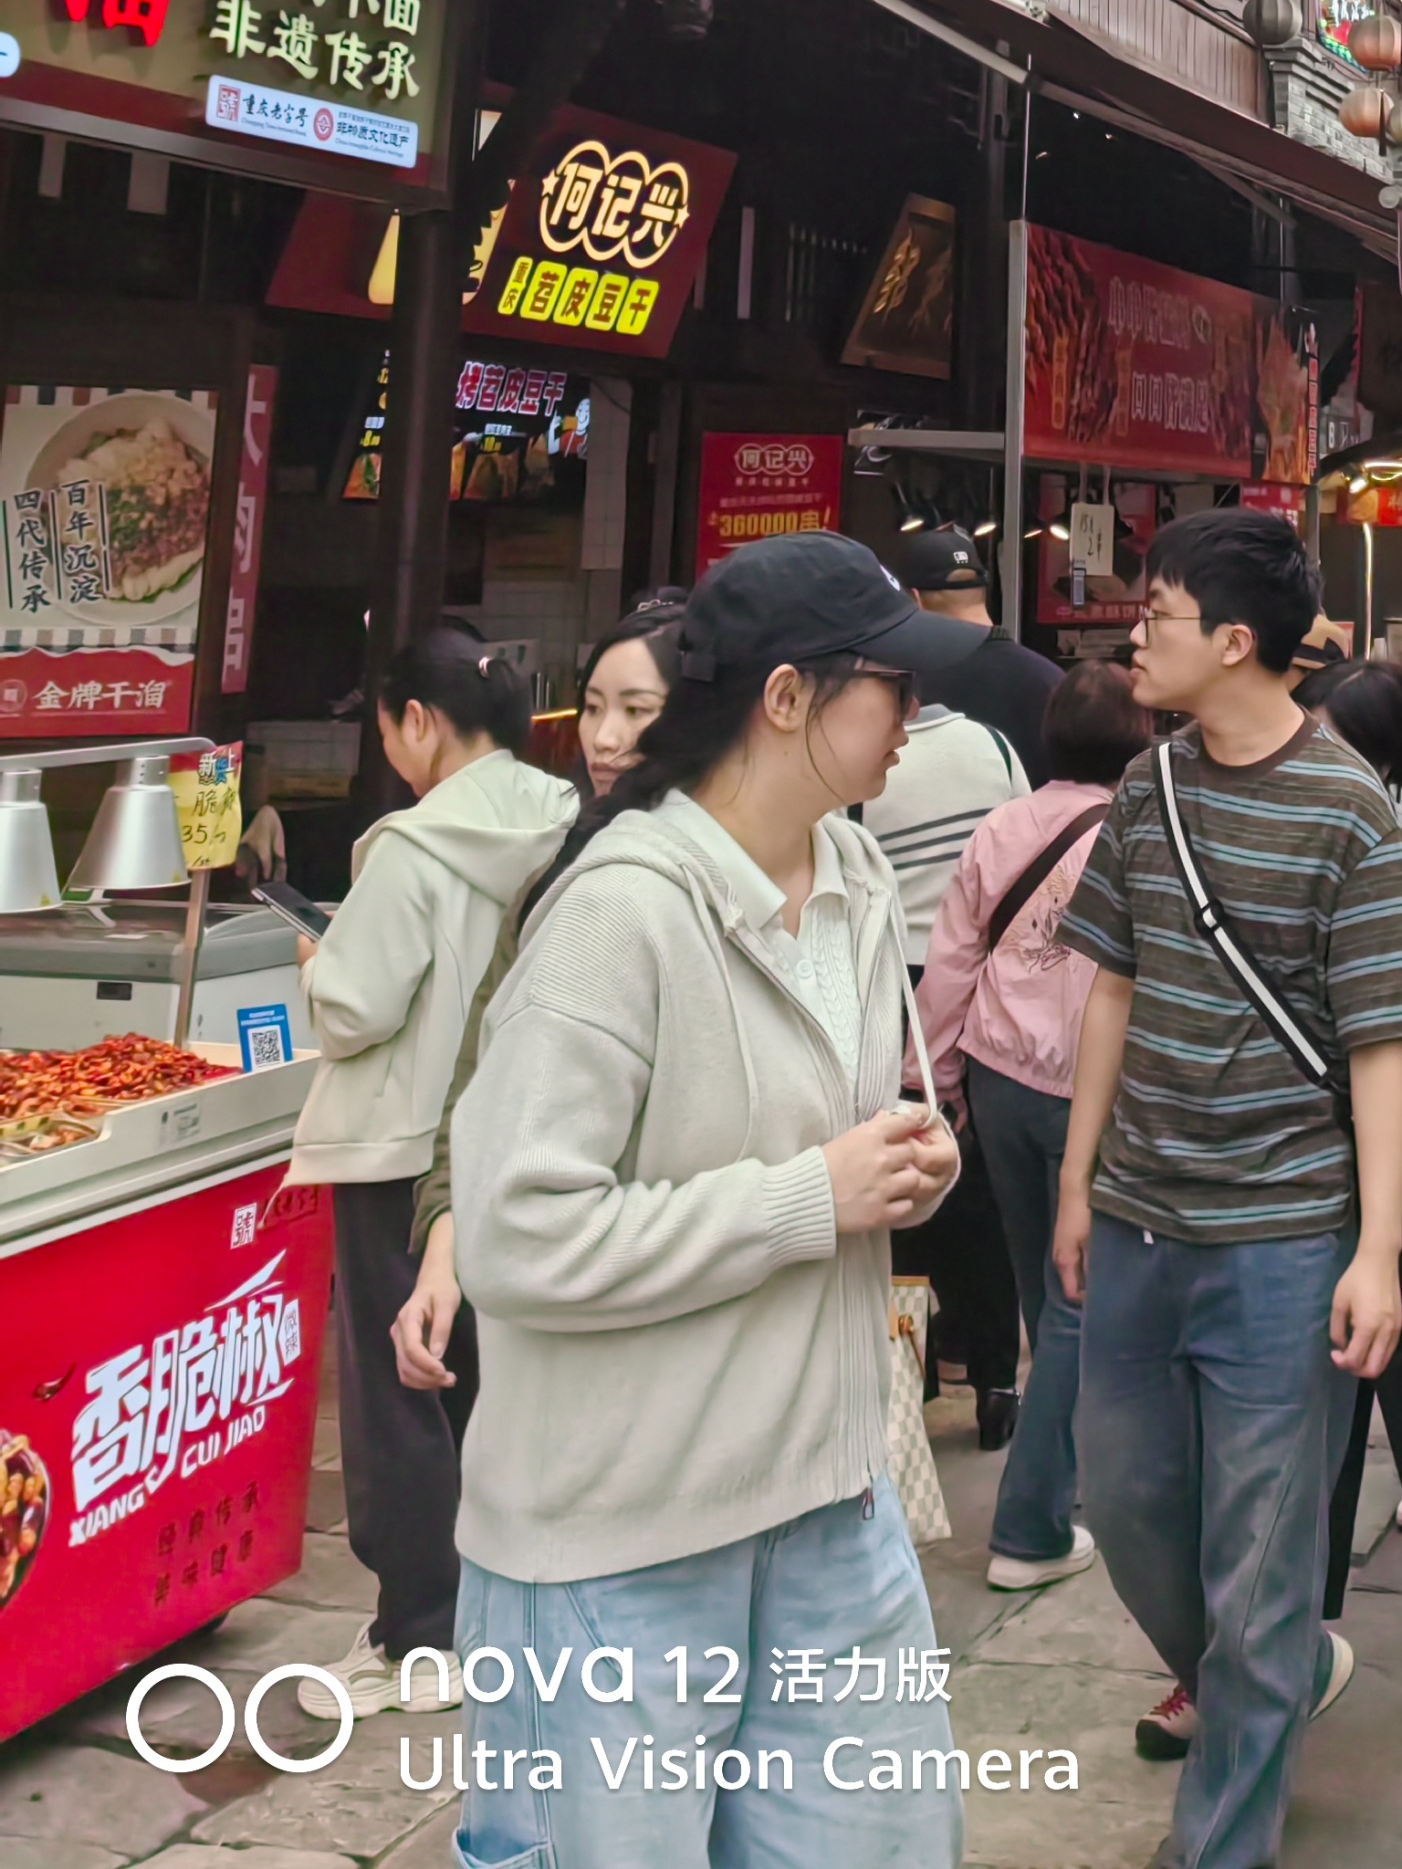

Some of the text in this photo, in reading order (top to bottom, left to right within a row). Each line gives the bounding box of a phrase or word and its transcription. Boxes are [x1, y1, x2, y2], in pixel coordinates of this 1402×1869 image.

[336, 121, 410, 148] 非物质文化遗产
[550, 163, 679, 248] 何记兴
[502, 261, 652, 327] 重庆 苕皮豆干
[14, 490, 52, 613] 四代传承
[60, 479, 101, 603] 百年沉淀
[32, 680, 167, 710] 金牌干溜
[71, 1291, 284, 1514] 香脆椒
[68, 1404, 266, 1548] XIANG CUI JIAO
